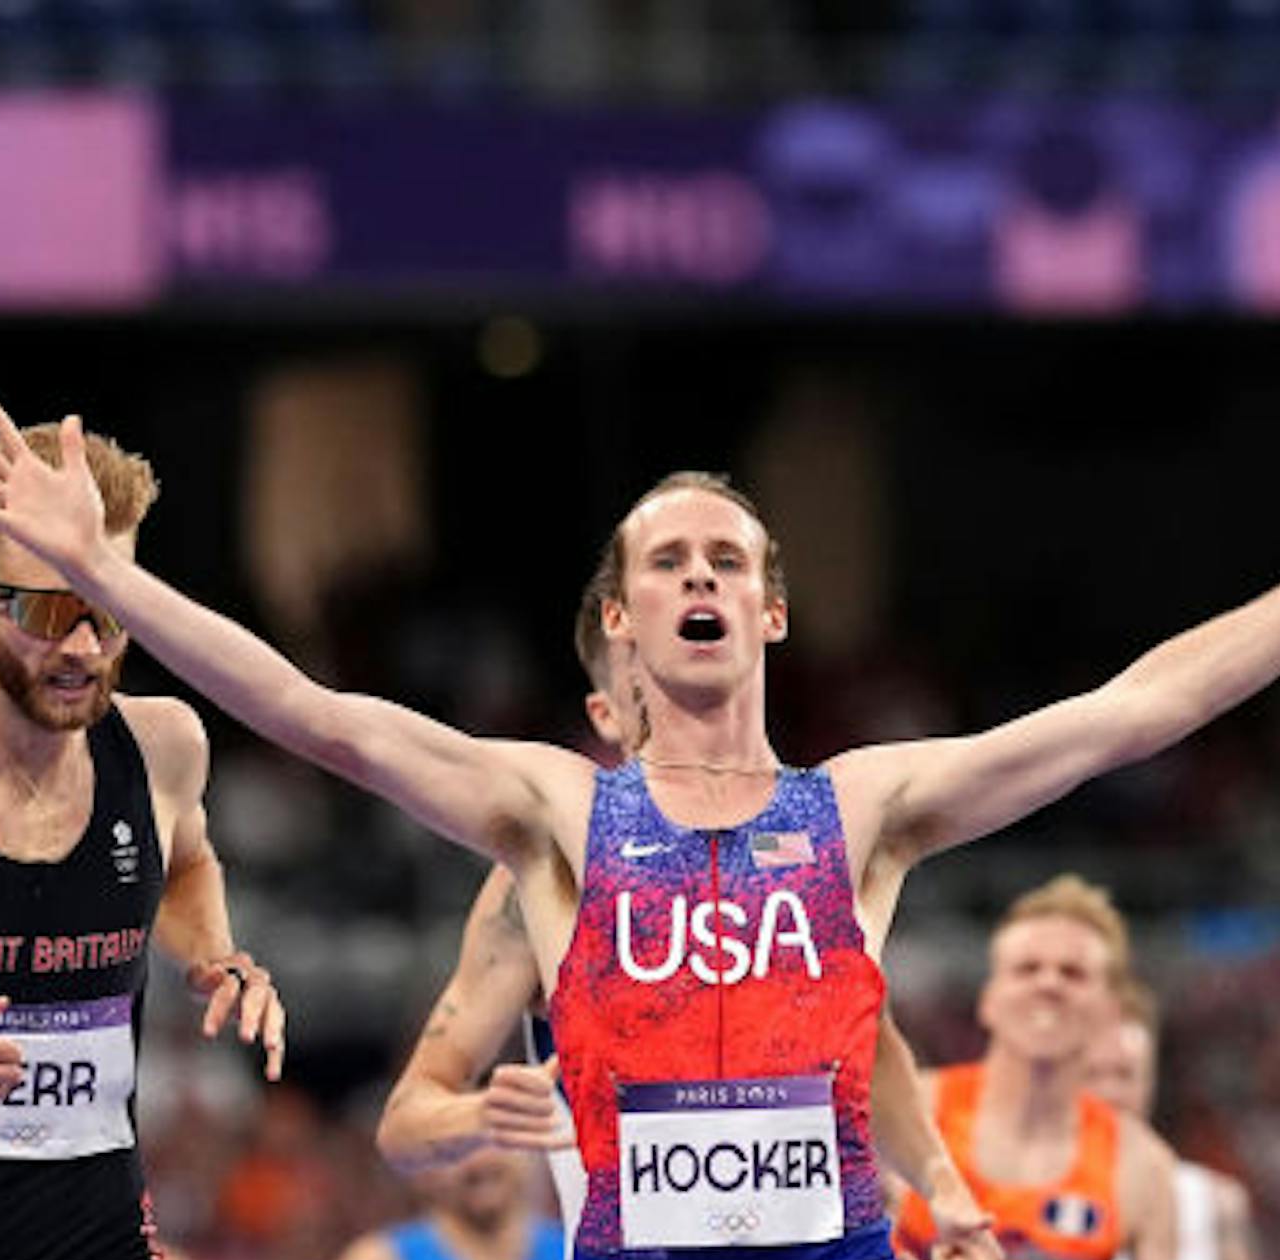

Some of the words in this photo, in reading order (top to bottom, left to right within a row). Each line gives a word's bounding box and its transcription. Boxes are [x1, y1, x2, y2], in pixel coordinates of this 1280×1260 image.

[617, 889, 821, 986] USA
[1, 1061, 96, 1106] ERR
[676, 1085, 729, 1105] PARIS
[736, 1084, 788, 1104] 2024
[629, 1139, 833, 1193] HOCKER
